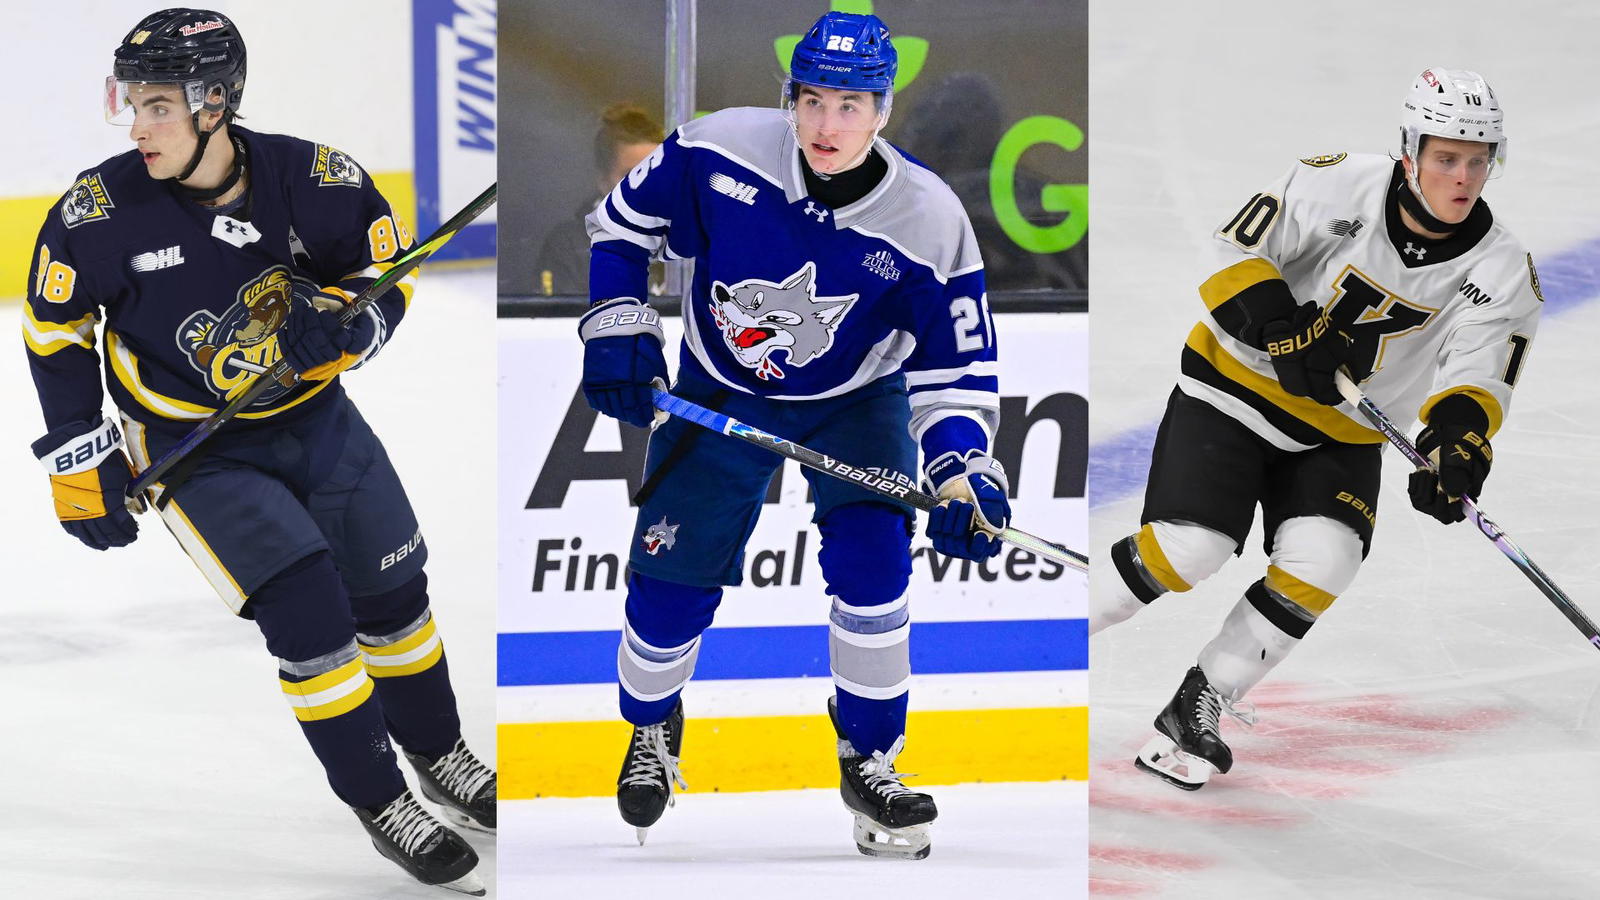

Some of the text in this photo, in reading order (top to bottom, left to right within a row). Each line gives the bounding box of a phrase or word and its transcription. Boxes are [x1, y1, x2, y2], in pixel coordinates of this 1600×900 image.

[180, 20, 224, 36] Tim Hortons
[826, 35, 855, 52] 26
[818, 64, 852, 73] BAUER
[1463, 93, 1482, 106] 10
[1459, 118, 1488, 126] BAUER
[90, 177, 108, 206] ERIE
[709, 172, 759, 206] OHL
[131, 245, 185, 273] OHL
[863, 255, 900, 280] ZULICH
[833, 463, 910, 498] BAUER
[865, 466, 917, 493] AUER
